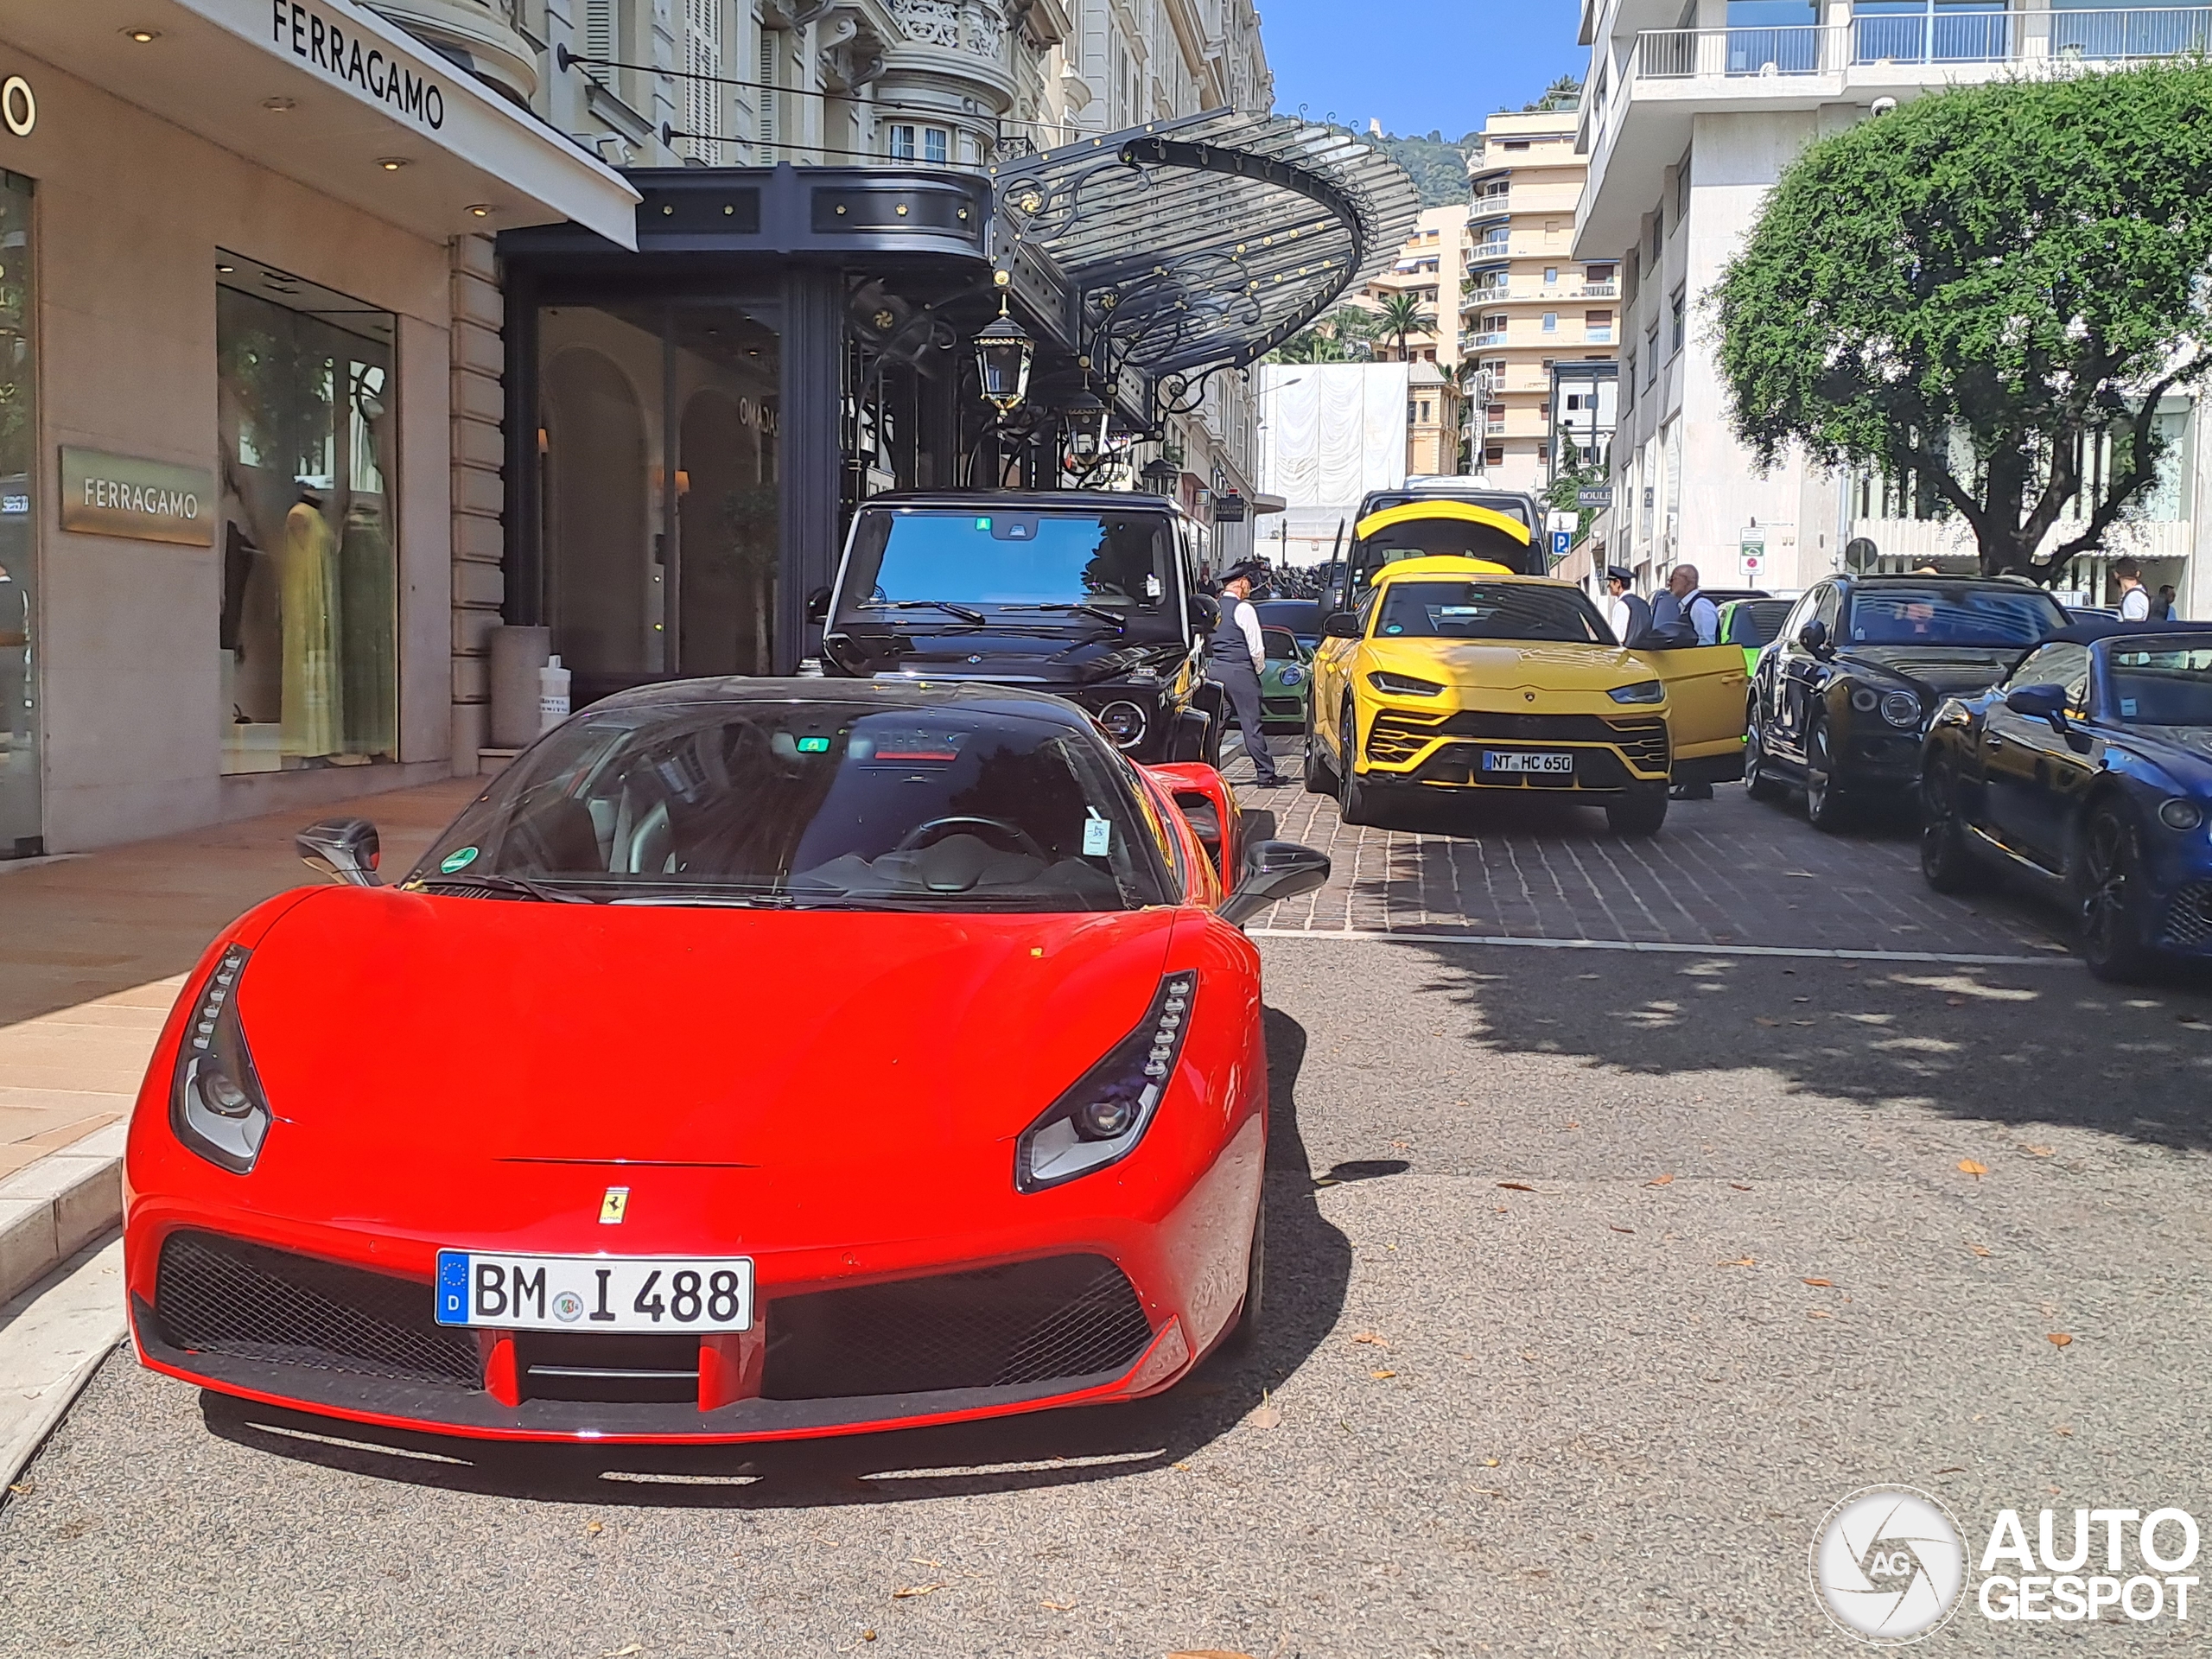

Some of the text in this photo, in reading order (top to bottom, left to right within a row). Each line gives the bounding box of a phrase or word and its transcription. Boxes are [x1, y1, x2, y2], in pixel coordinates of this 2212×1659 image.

[273, 0, 443, 130] FERRAGAMO
[84, 478, 198, 519] FERRAGAMO
[1492, 754, 1512, 770] NT
[1522, 755, 1541, 770] HC
[448, 1263, 740, 1323] D BM I 488
